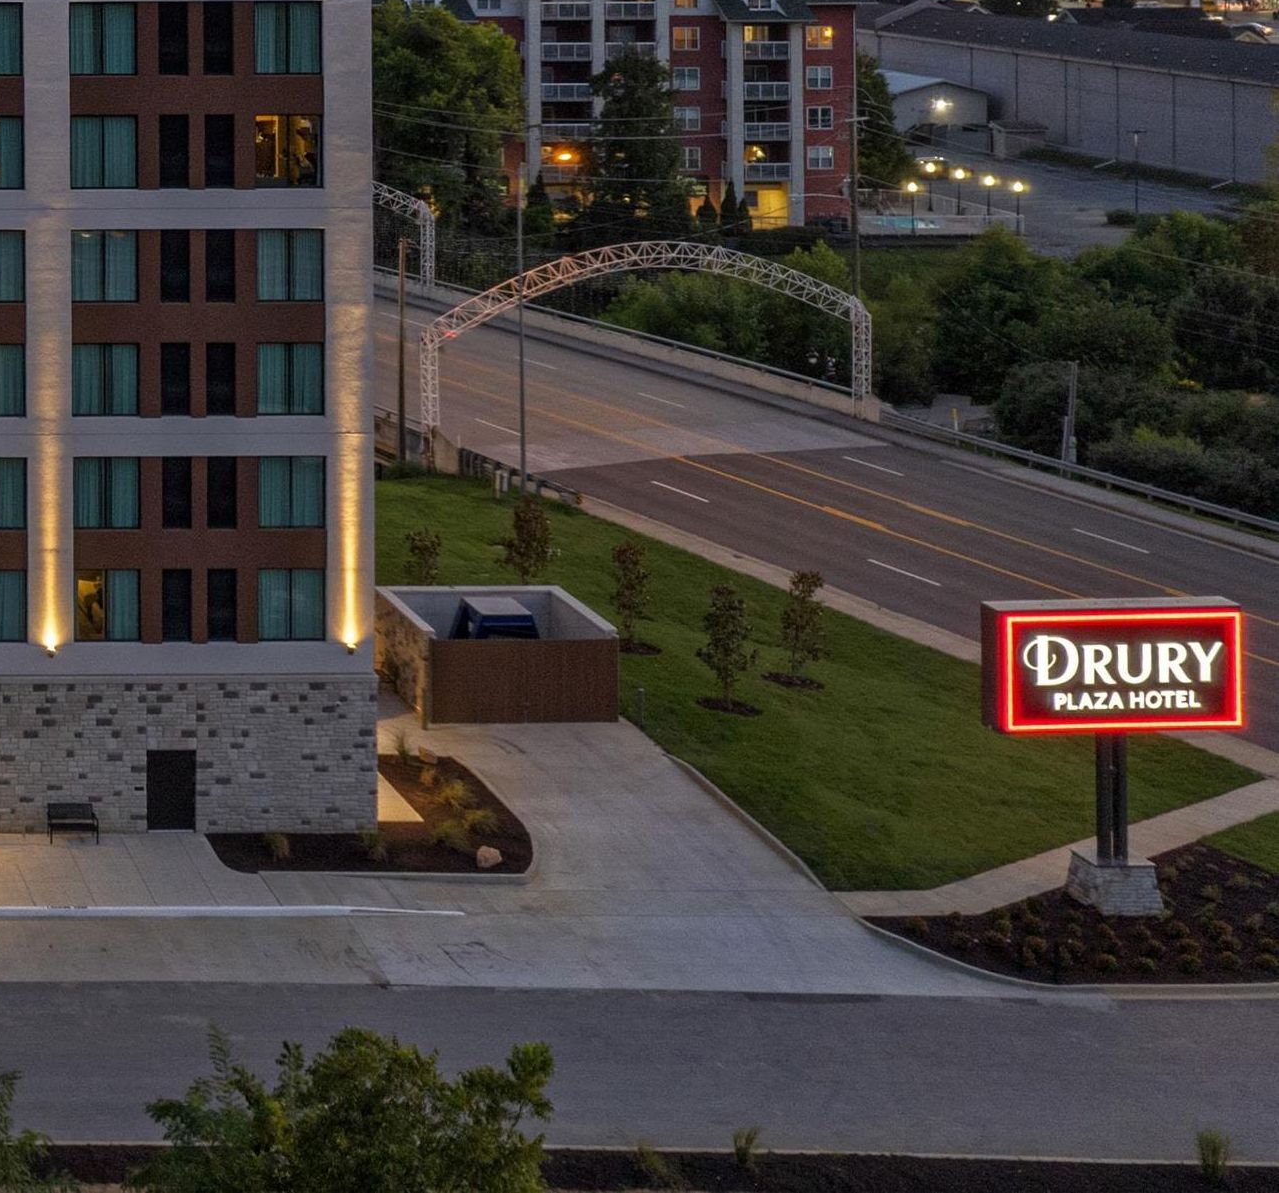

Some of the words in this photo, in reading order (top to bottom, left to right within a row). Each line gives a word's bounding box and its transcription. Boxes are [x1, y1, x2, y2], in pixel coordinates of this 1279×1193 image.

[1023, 635, 1223, 686] DRURY
[1054, 692, 1124, 710] PLAZA
[1129, 690, 1201, 709] HOTEL
